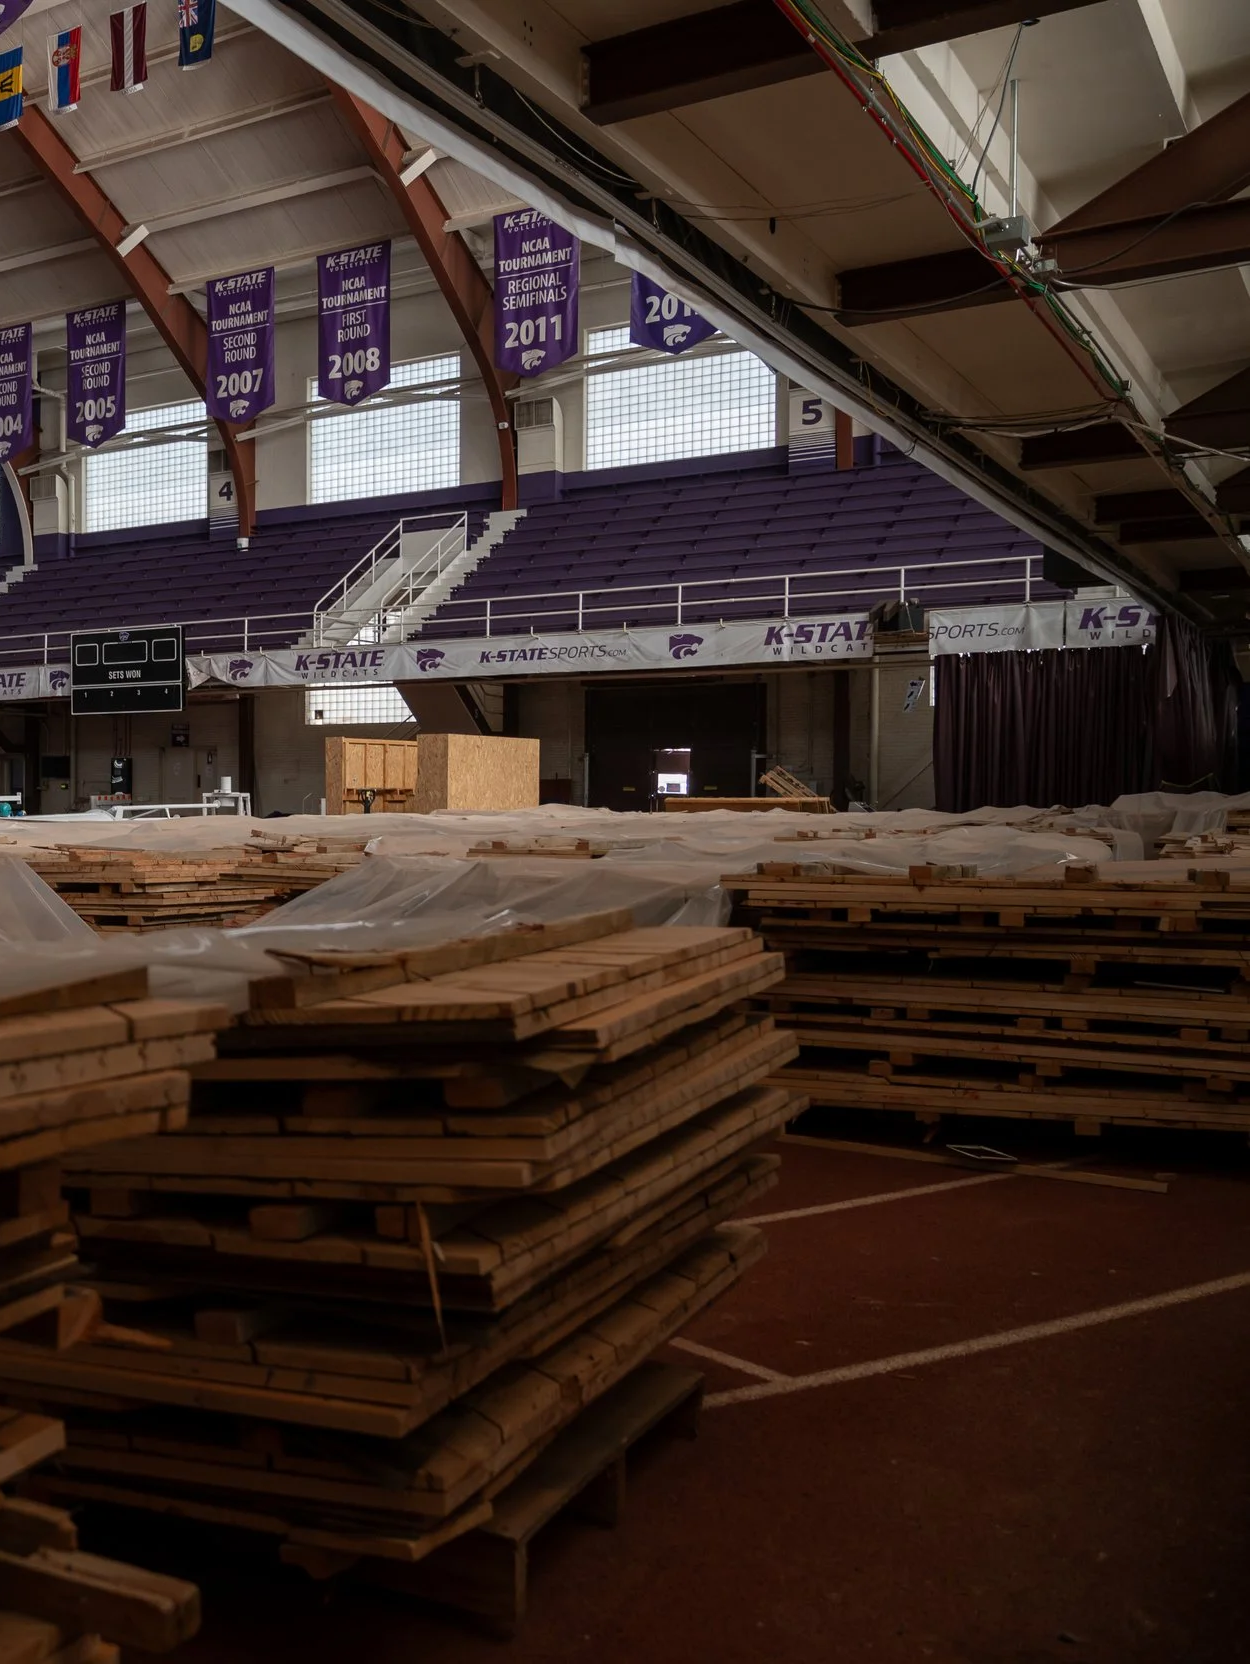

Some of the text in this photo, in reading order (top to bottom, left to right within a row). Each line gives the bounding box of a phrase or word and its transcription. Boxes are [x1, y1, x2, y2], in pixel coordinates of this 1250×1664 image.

[504, 210, 549, 229] K-ST
[522, 236, 550, 254] NCAA
[326, 245, 383, 269] K-STATE
[330, 258, 378, 273] VOLLEYBALL
[498, 247, 572, 273] TOURNAMENT
[214, 271, 267, 292] K-STATE
[342, 276, 366, 292] NCAA
[508, 272, 562, 294] REGIONAL
[322, 286, 386, 309] TOURNAMENT
[502, 286, 567, 311] SEMIFINALS
[73, 305, 119, 324] K-STATE
[229, 300, 252, 315] NCAA
[211, 310, 268, 332] TOURNAMENT
[342, 309, 366, 327] FIRST
[86, 332, 106, 345] NCAA
[338, 324, 370, 343] ROUND
[505, 314, 562, 348] 2011
[70, 341, 120, 360] TOURNAMENT
[222, 332, 257, 350] SECOND
[224, 346, 256, 364] ROUND
[328, 346, 380, 380] 2008
[81, 362, 110, 378] SECOND
[82, 375, 110, 390] ROUND
[216, 368, 264, 399] 2007
[76, 395, 116, 424] 2005
[802, 399, 822, 425] 5
[219, 481, 233, 501] 4
[764, 620, 869, 645] K-STAT
[479, 645, 627, 663] K-STATESPORTS.COM
[772, 643, 867, 655] WILDCAT
[295, 650, 384, 671] K-STATE
[108, 670, 141, 680] SETS WON
[301, 669, 378, 679] WILDCATS
